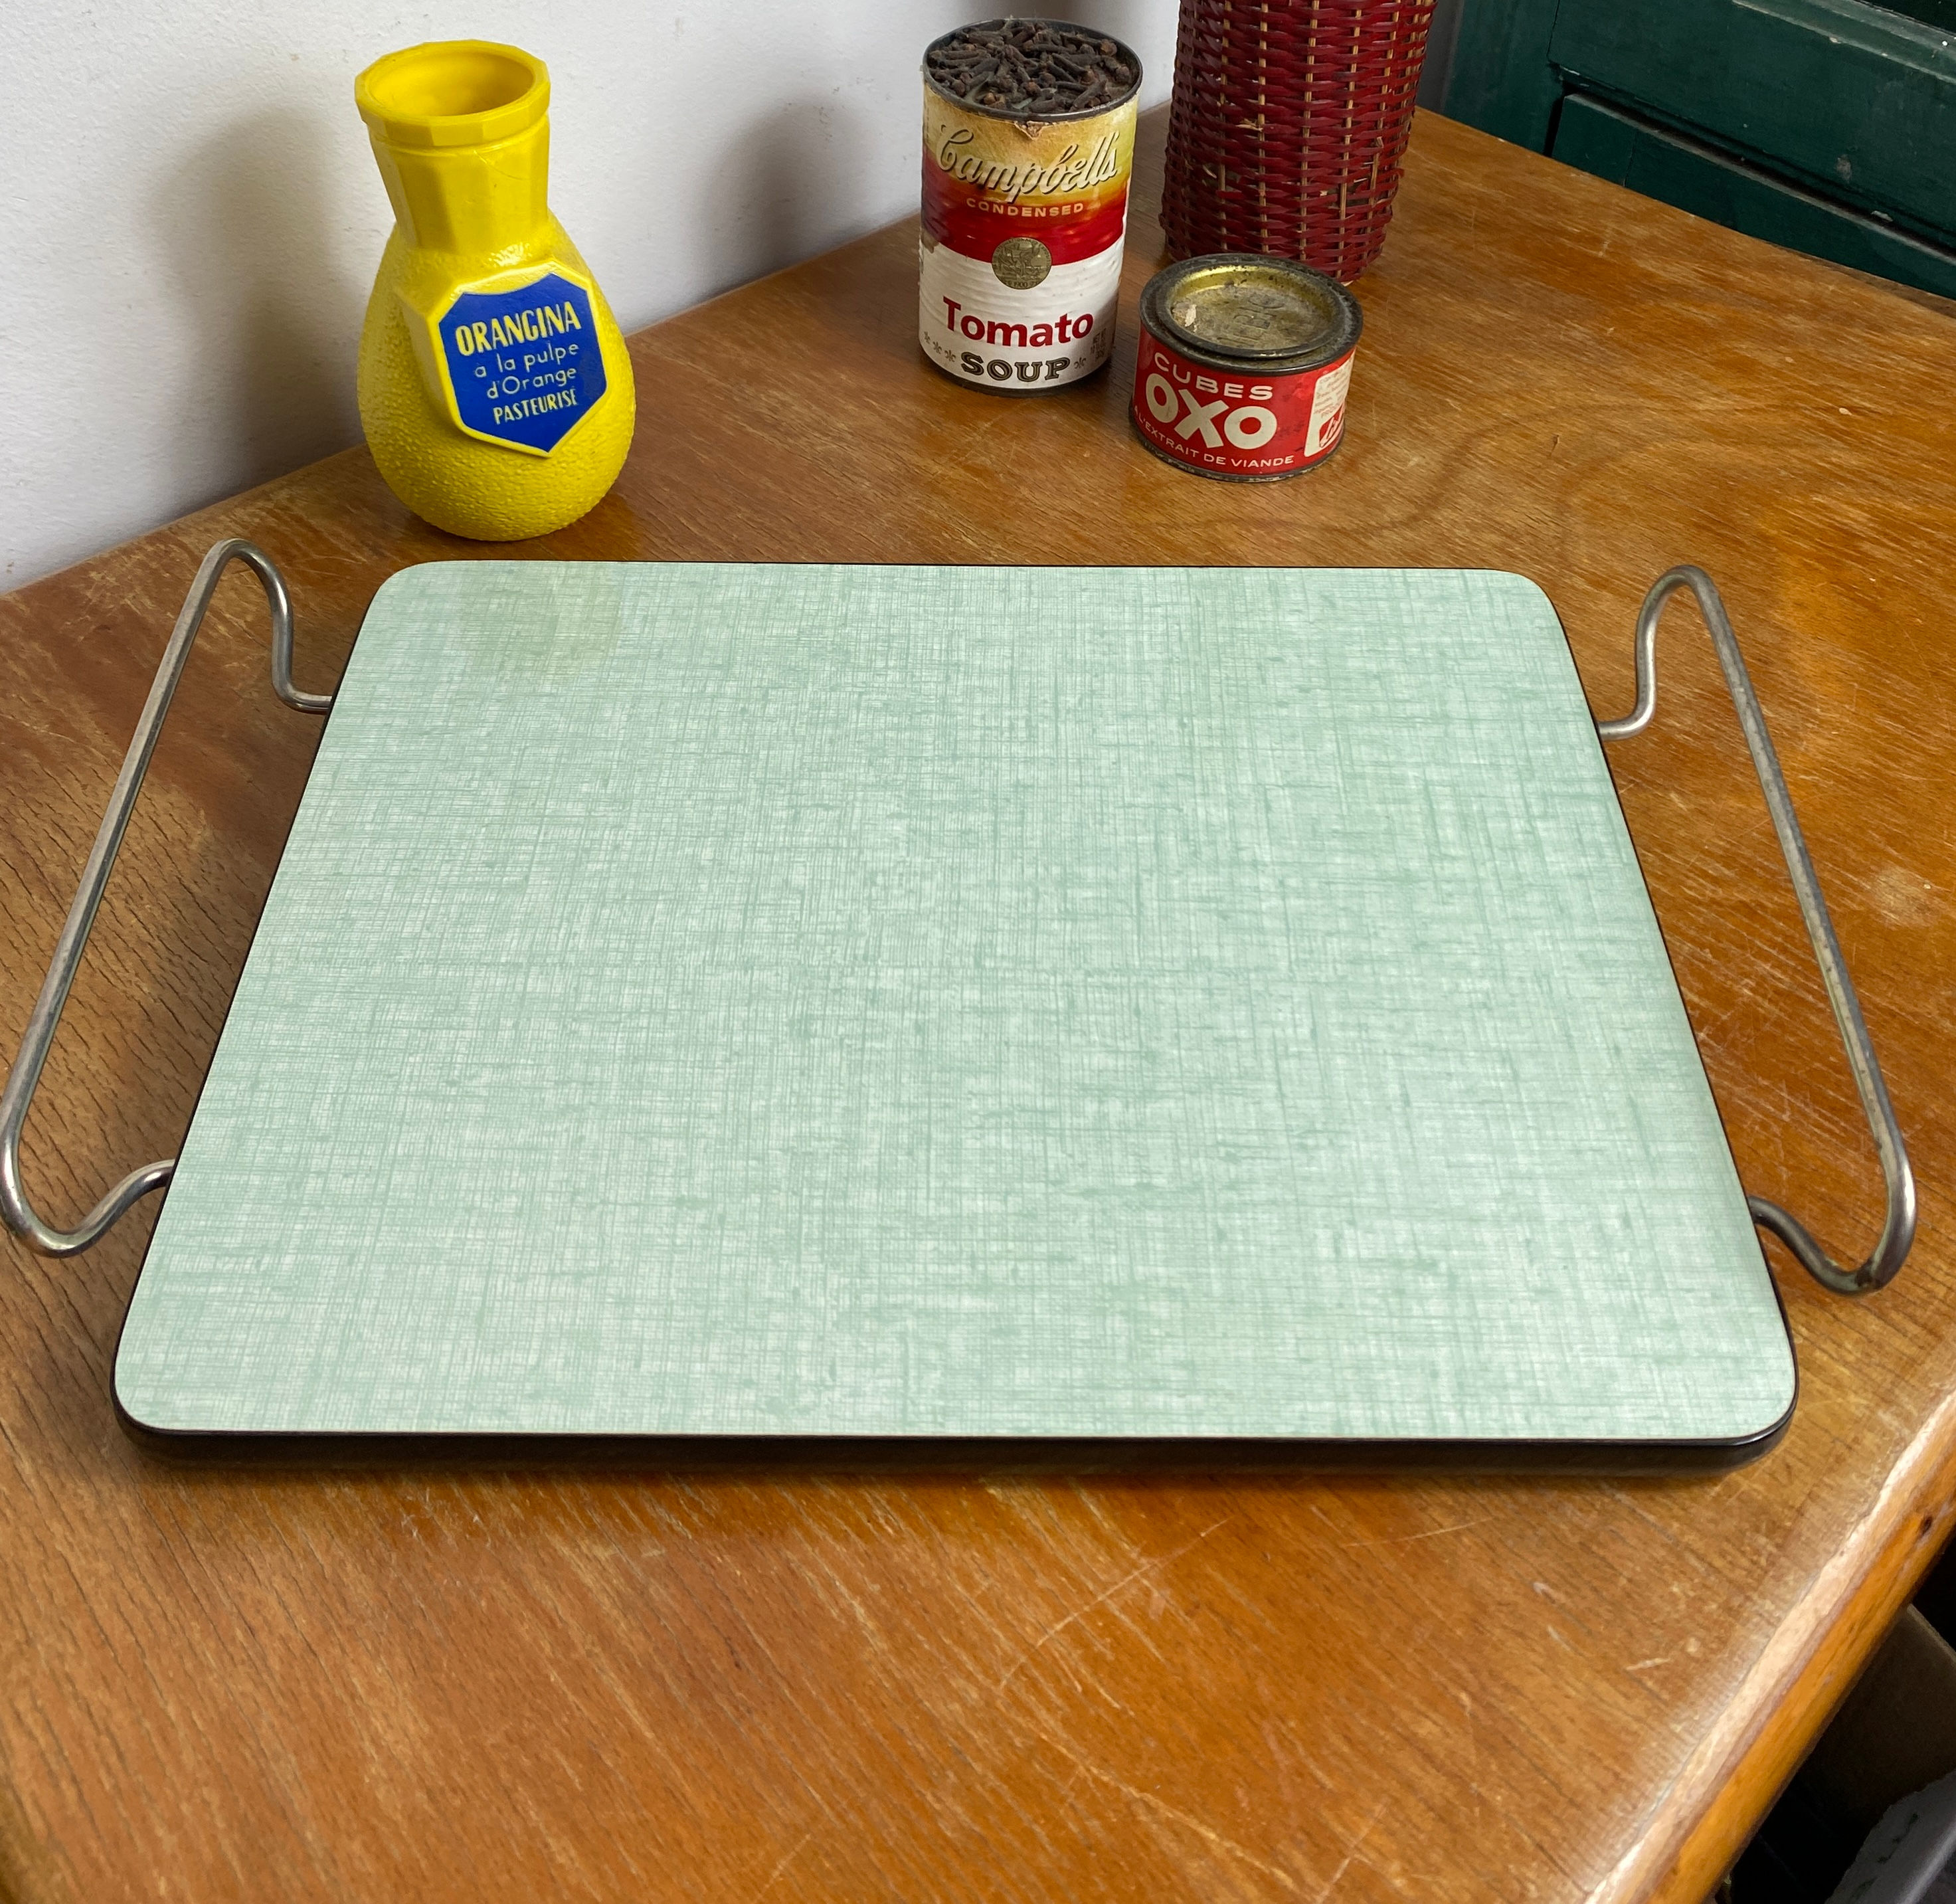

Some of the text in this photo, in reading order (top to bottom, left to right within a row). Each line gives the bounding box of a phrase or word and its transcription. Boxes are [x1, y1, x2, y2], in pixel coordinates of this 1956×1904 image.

[966, 198, 1084, 217] CONDENSED
[455, 302, 581, 356] ORANGINA
[942, 296, 1094, 347] Tomato
[496, 353, 515, 373] la
[523, 340, 579, 373] pulpe
[960, 351, 1070, 382] SOUP
[1154, 352, 1273, 401] CUBES
[1146, 373, 1278, 450] OXO
[1138, 413, 1200, 458] L'EXTRAIT
[1203, 453, 1227, 465] DE
[1231, 455, 1294, 468] VIANDE
